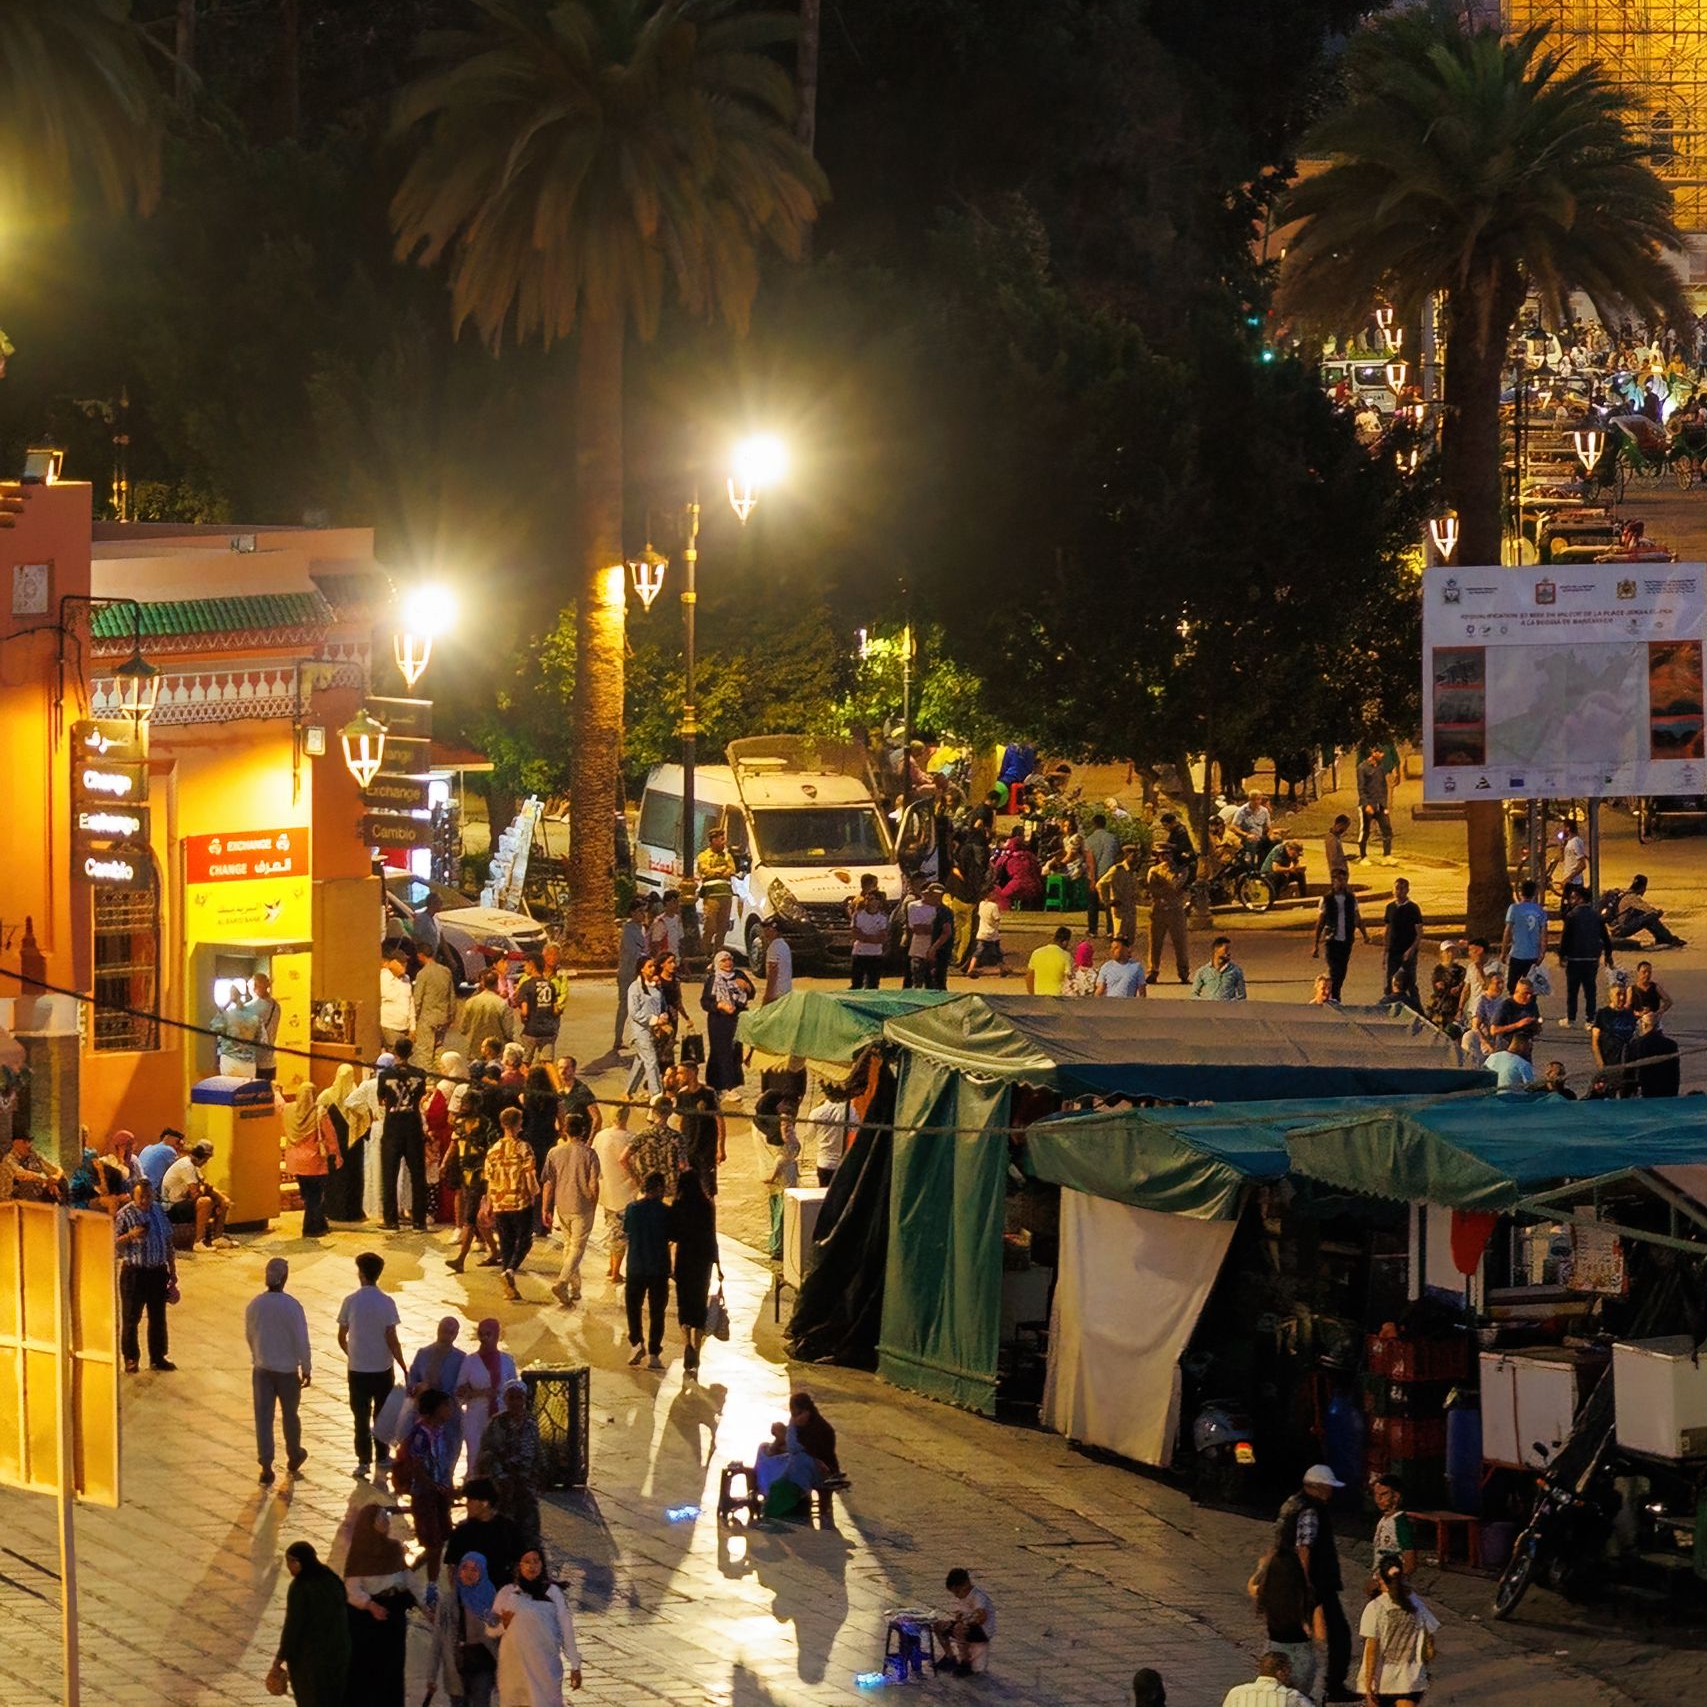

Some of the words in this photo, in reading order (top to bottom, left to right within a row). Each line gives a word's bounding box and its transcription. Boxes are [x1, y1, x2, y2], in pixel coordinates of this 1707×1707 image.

[366, 785, 421, 802] Exchange
[372, 823, 417, 841] Cambio
[209, 862, 248, 876] CHANGE
